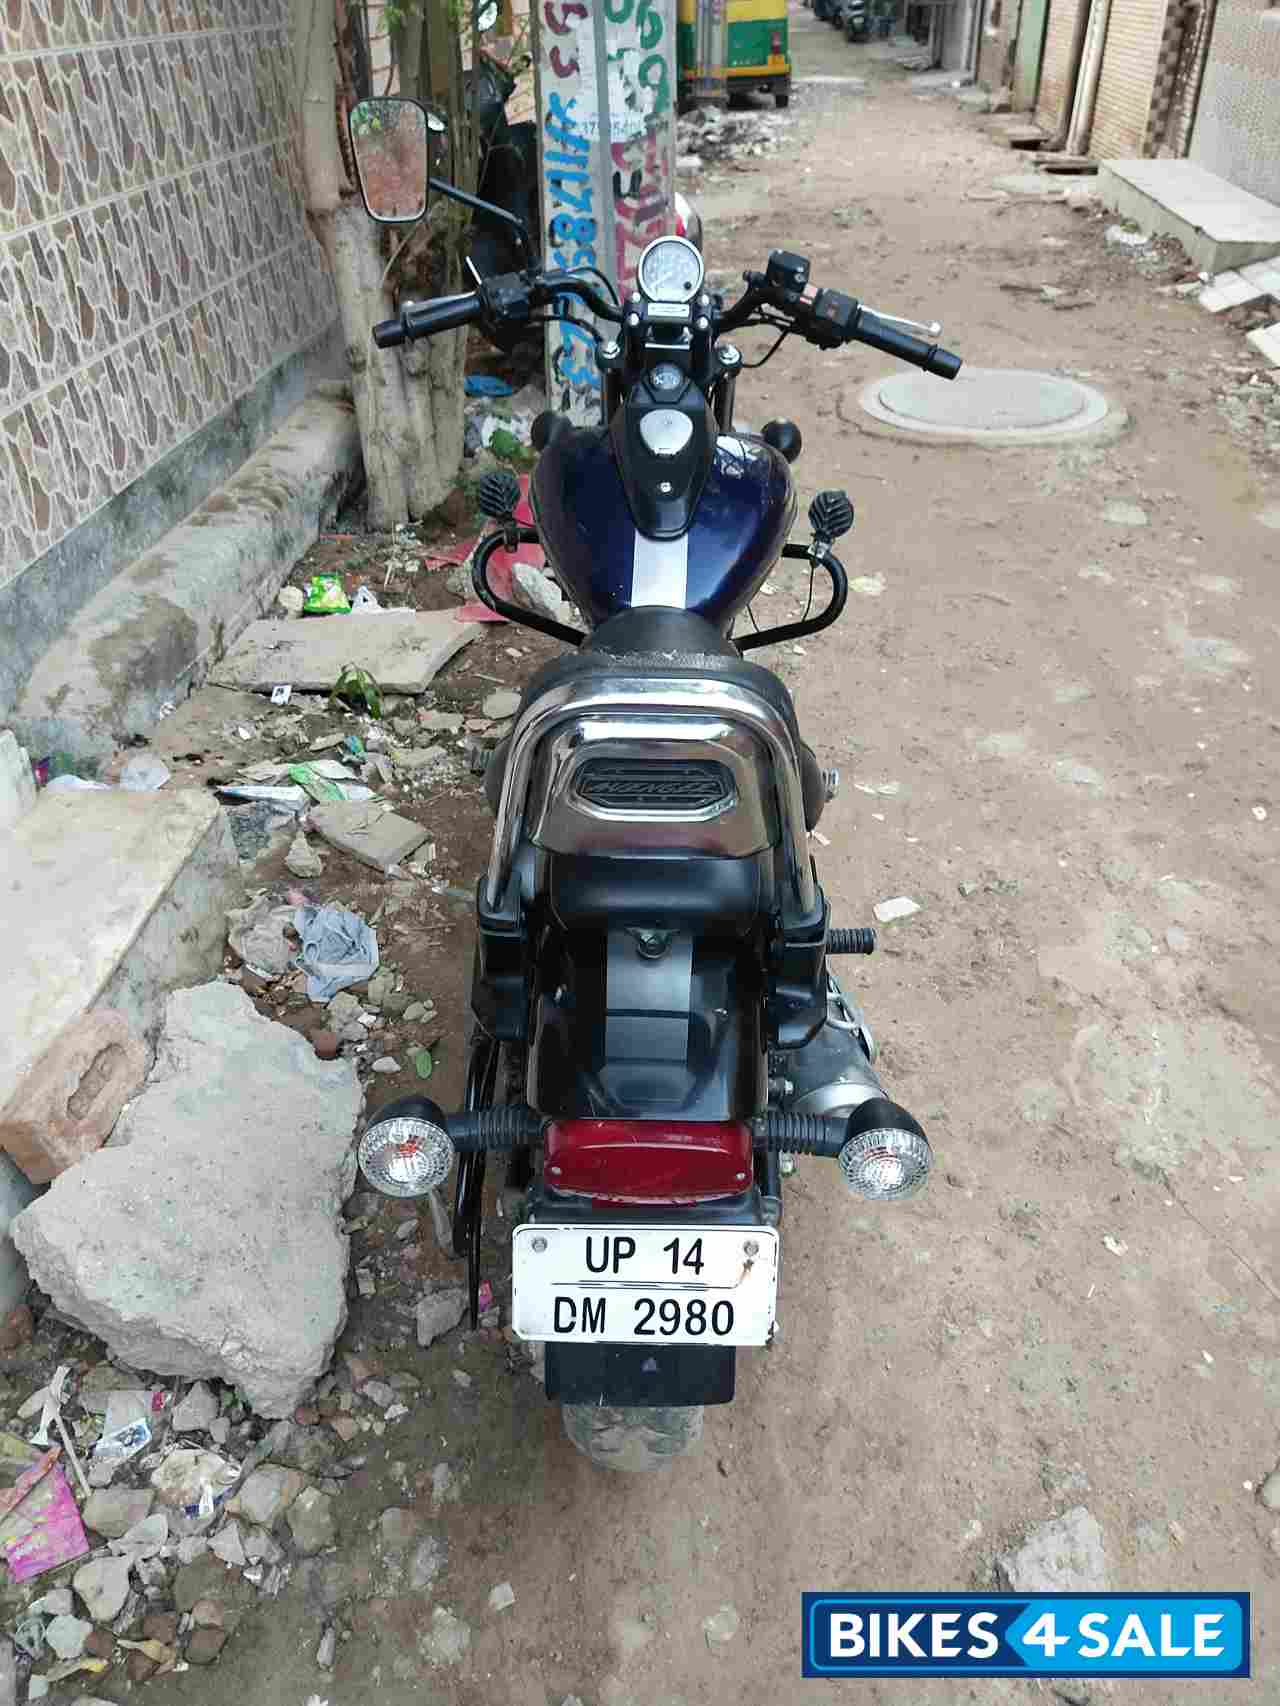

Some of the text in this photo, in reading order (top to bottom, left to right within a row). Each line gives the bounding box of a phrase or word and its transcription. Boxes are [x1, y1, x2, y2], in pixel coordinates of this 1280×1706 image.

[586, 1237, 705, 1275] UP 14
[554, 1296, 734, 1336] DM 2980
